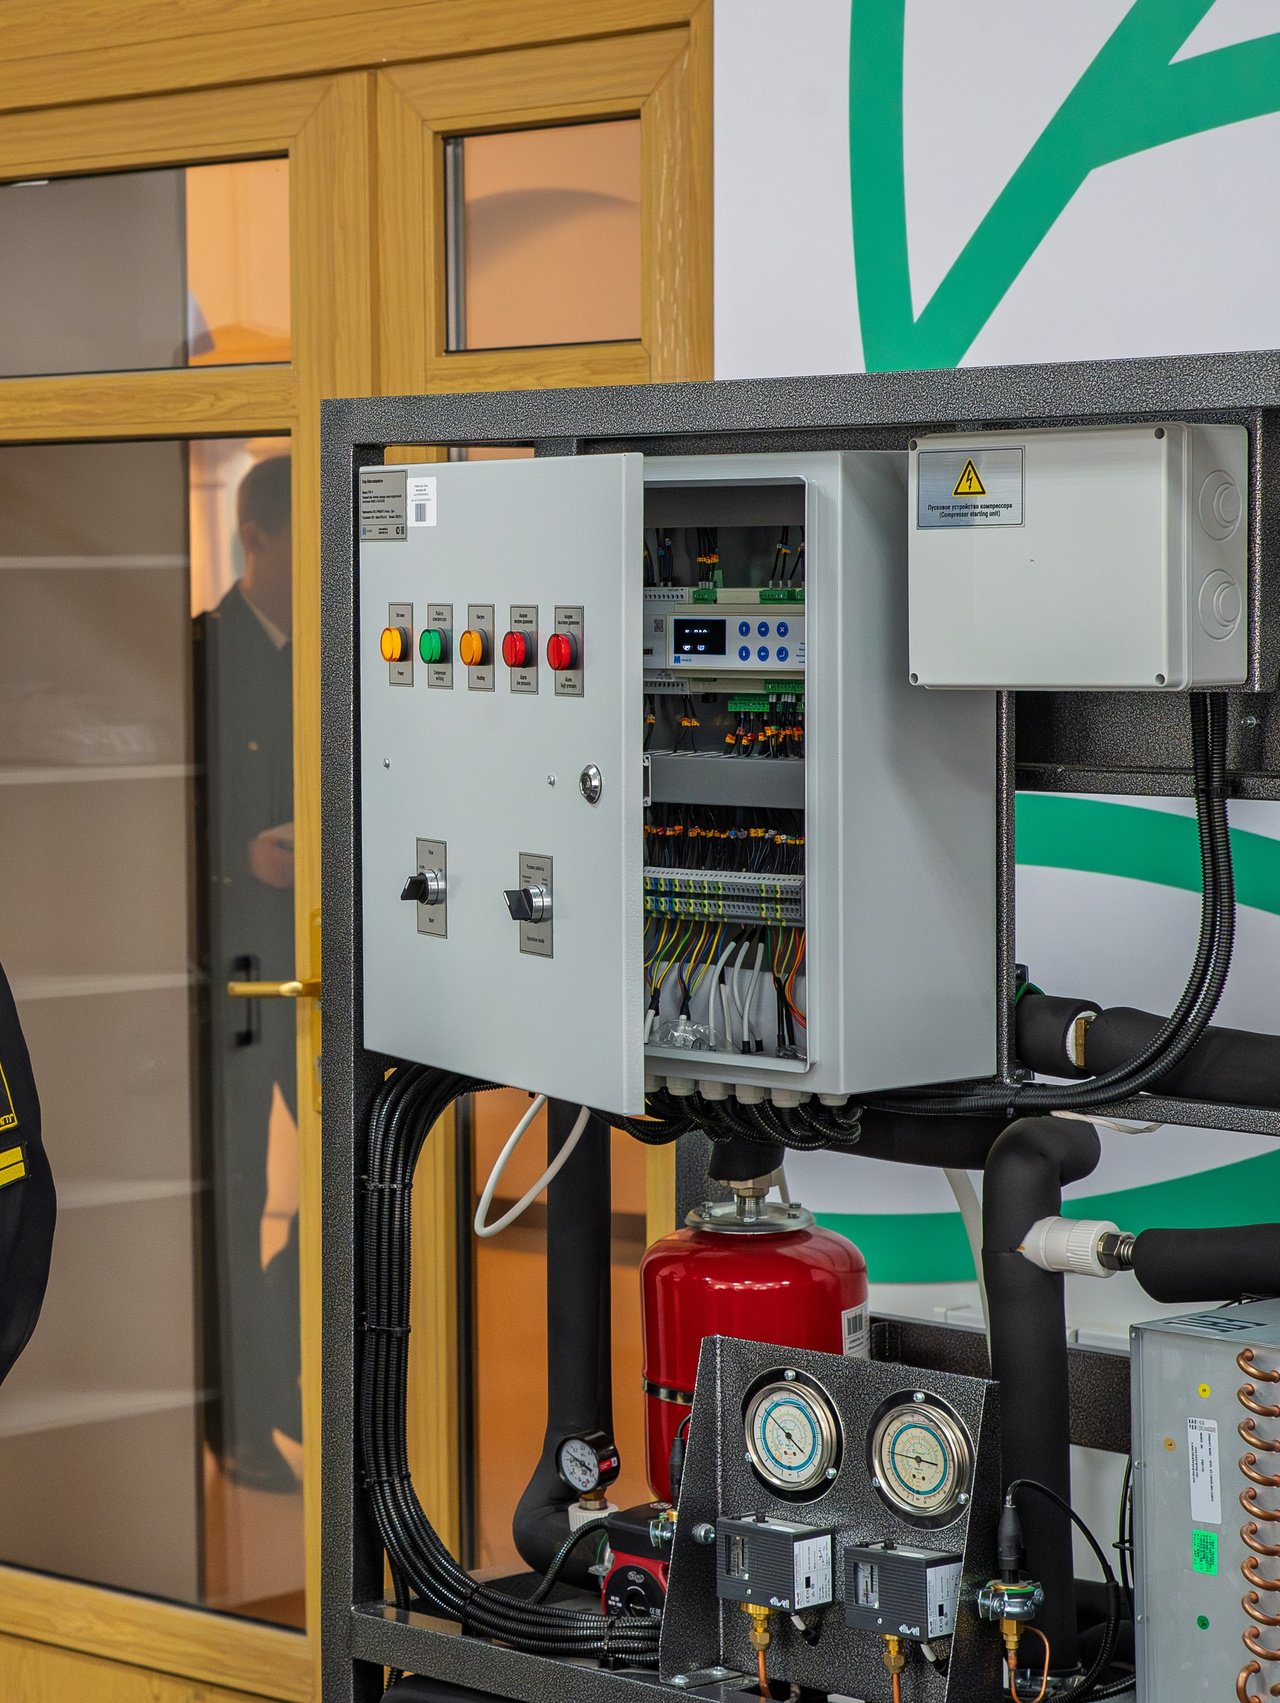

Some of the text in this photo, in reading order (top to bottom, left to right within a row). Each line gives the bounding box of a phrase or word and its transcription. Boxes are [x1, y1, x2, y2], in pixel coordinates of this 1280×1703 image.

[927, 504, 951, 512] Пусковое
[951, 503, 979, 511] устройство
[939, 509, 1001, 519] (Compressor starting unit)
